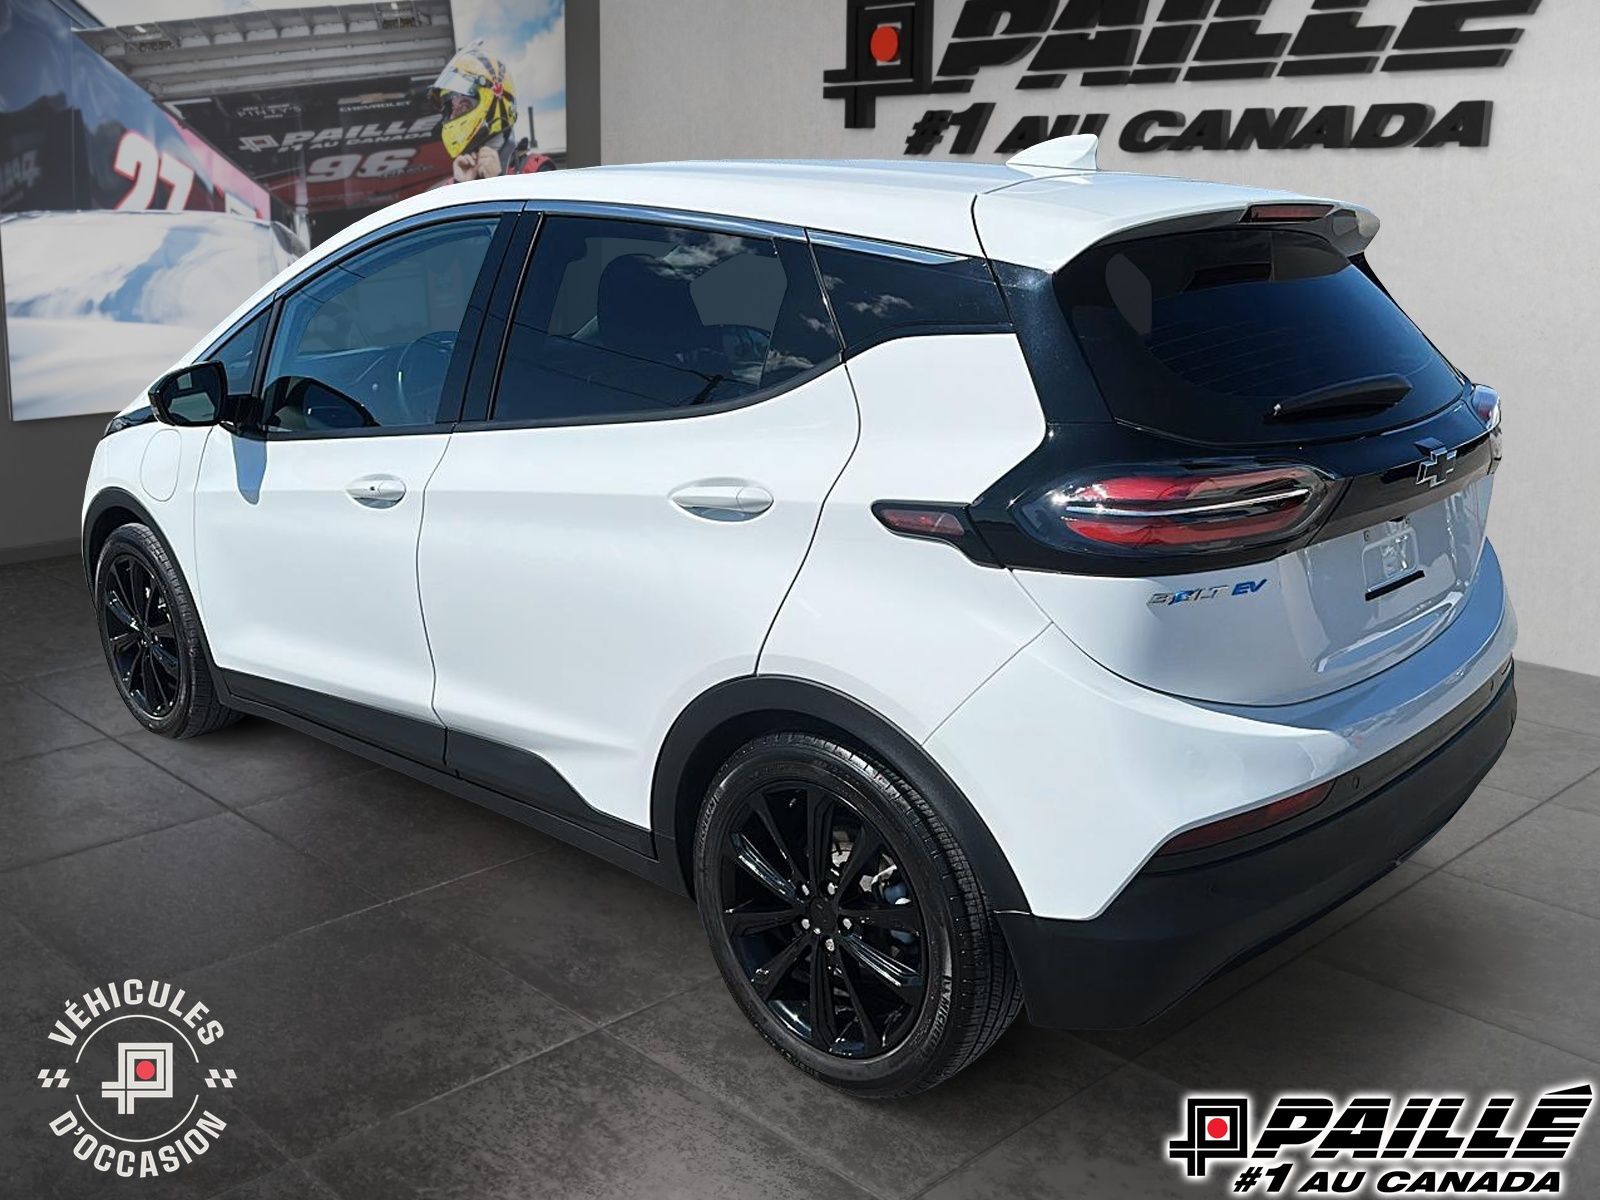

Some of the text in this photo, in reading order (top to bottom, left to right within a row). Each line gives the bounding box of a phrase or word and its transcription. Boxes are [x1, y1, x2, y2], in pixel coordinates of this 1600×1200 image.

[339, 100, 411, 112] CHEVROLET
[309, 140, 340, 150] AU
[346, 131, 432, 146] CANADA
[903, 102, 996, 155] #1
[1118, 100, 1493, 153] CANADA
[114, 130, 195, 212] 27
[306, 148, 416, 183] 96
[1231, 578, 1267, 596] EV
